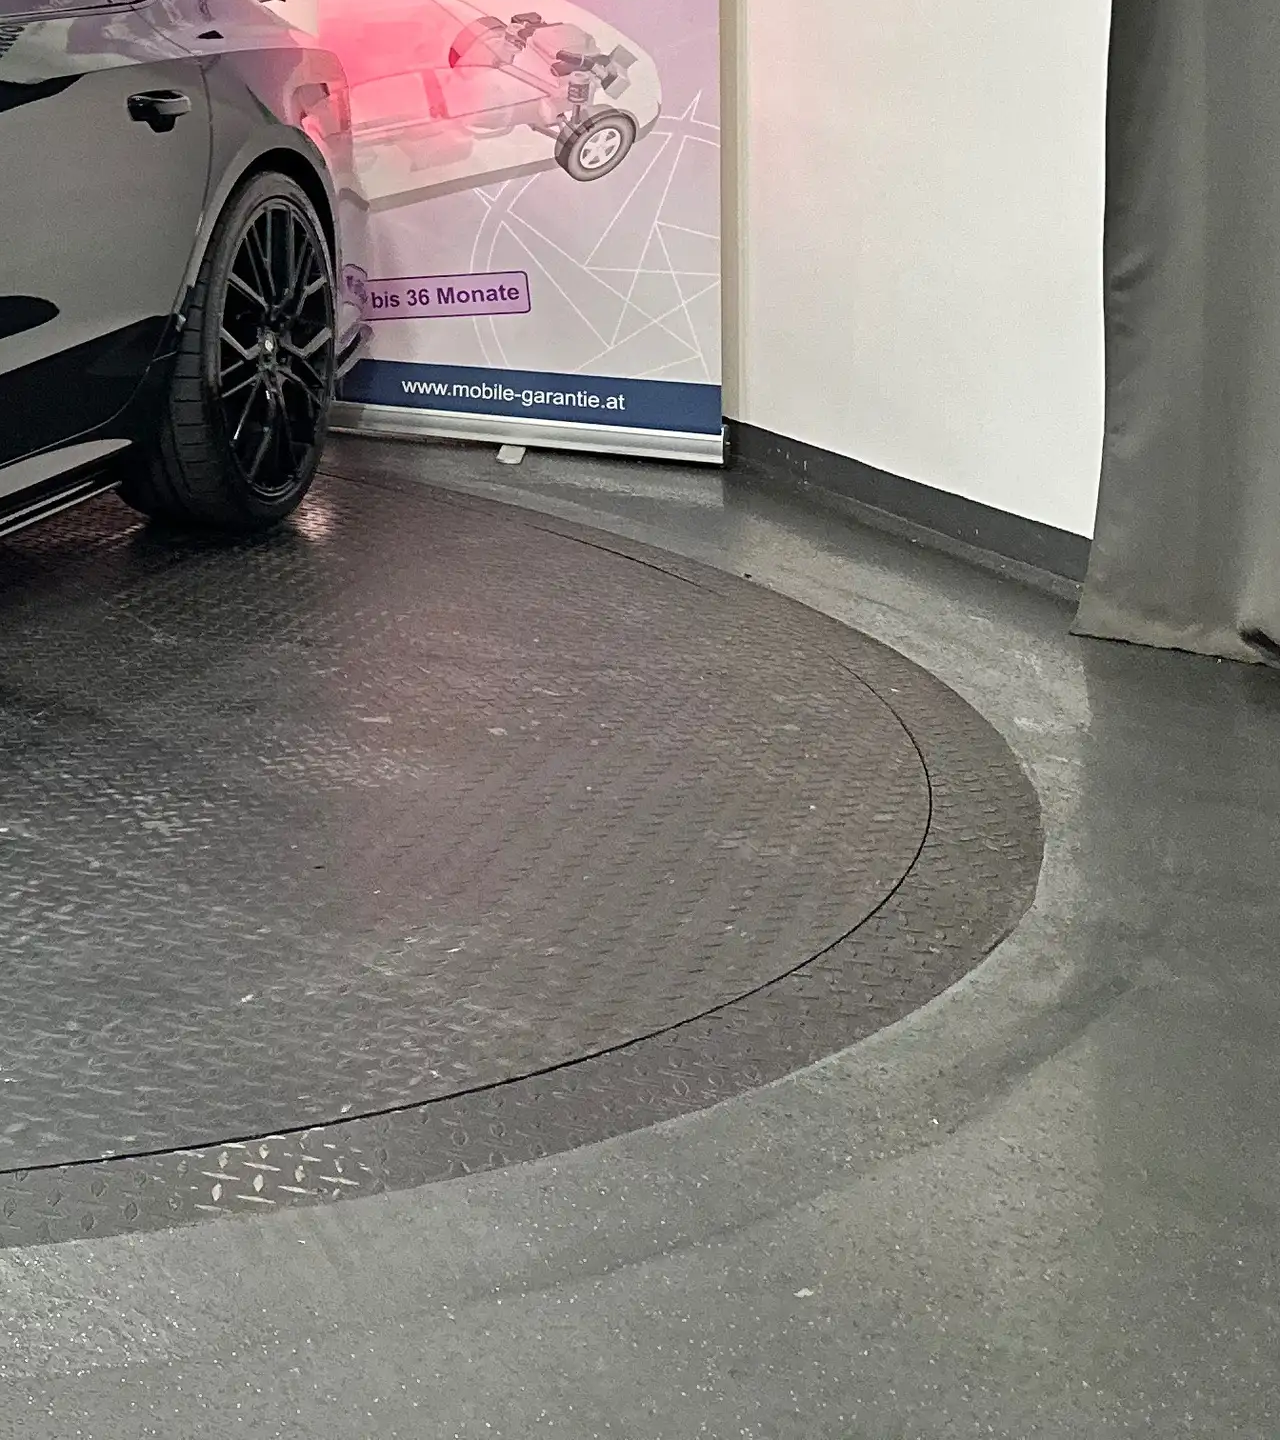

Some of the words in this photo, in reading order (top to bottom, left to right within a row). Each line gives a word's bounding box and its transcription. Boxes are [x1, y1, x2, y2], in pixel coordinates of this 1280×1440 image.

[371, 291, 401, 309] bis
[406, 288, 430, 307] 36
[436, 284, 521, 305] Monate
[401, 379, 627, 412] www.mobile-garantie.at
